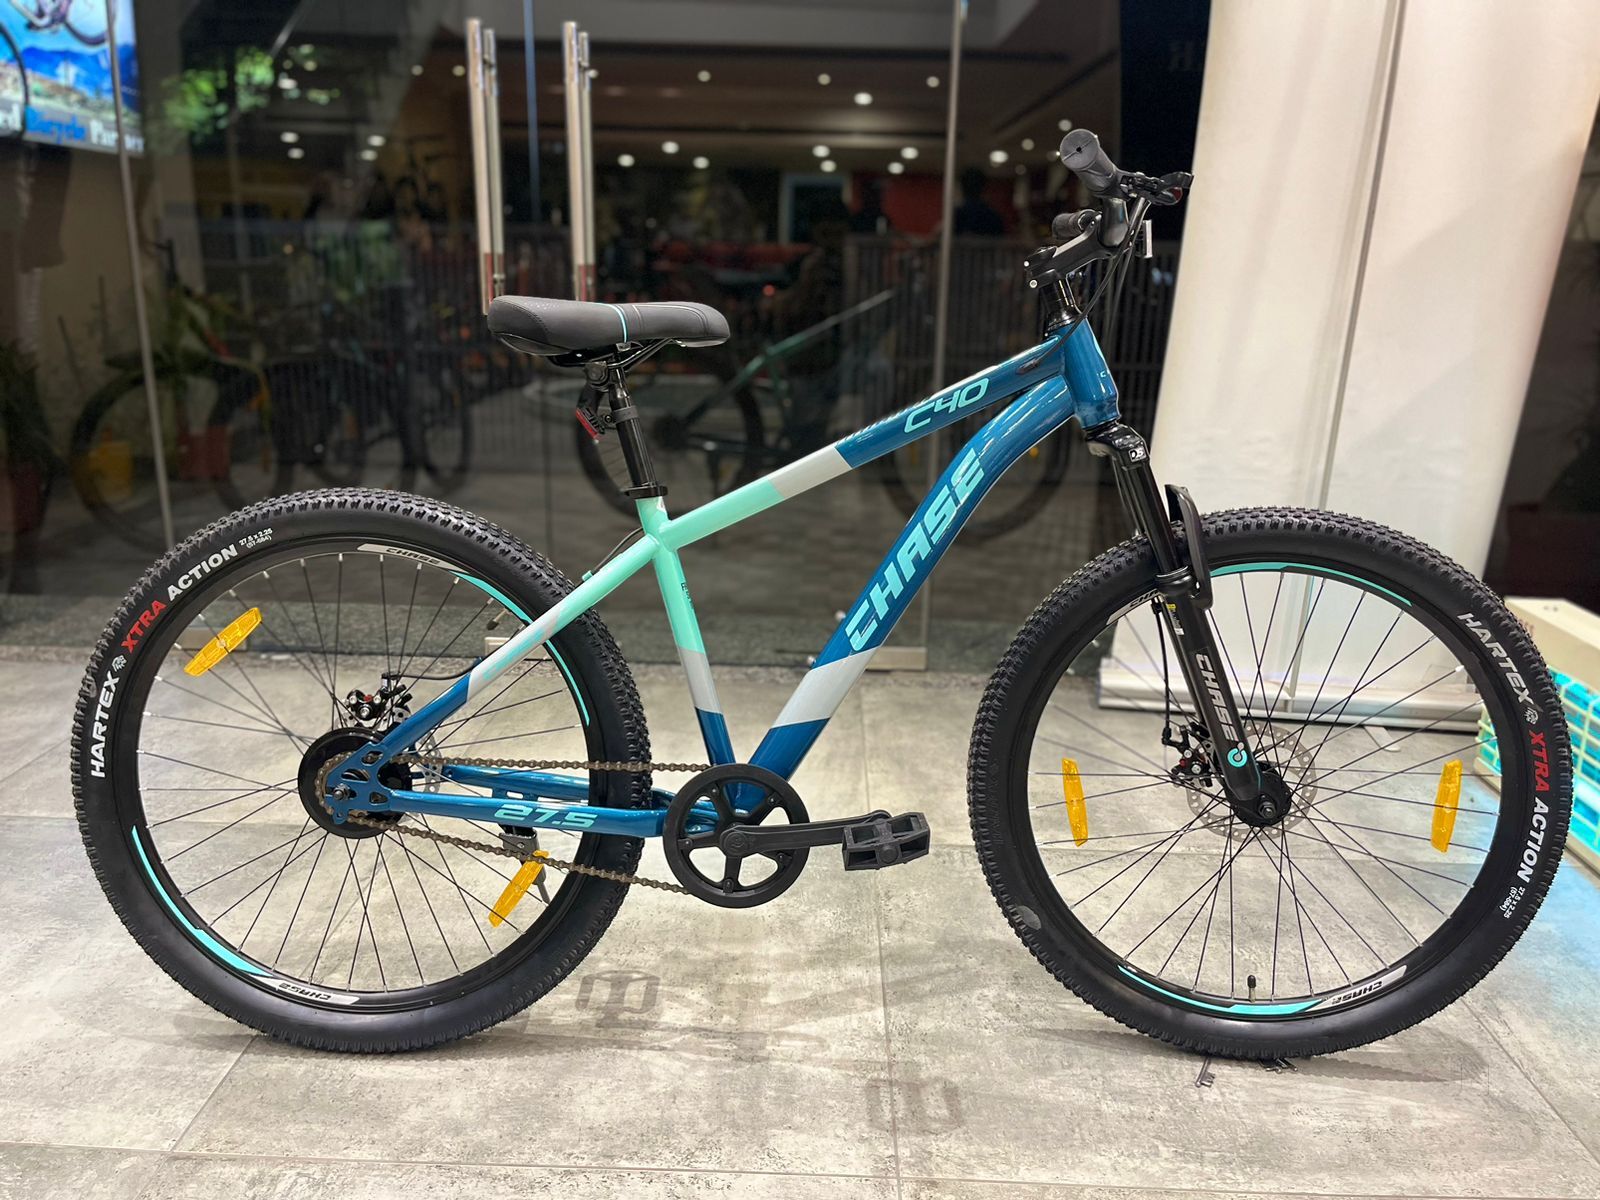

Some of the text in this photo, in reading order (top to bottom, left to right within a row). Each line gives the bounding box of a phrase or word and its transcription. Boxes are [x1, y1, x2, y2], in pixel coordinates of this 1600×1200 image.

[904, 377, 990, 434] C40
[845, 448, 985, 652] CHASE
[90, 544, 239, 778] HARTEX XTRA ACTION
[1195, 653, 1240, 742] CHASE
[1457, 612, 1540, 709] HARTEX
[1529, 729, 1550, 792] XTRA
[494, 803, 599, 829] 27.5
[1516, 796, 1550, 884] ACTION
